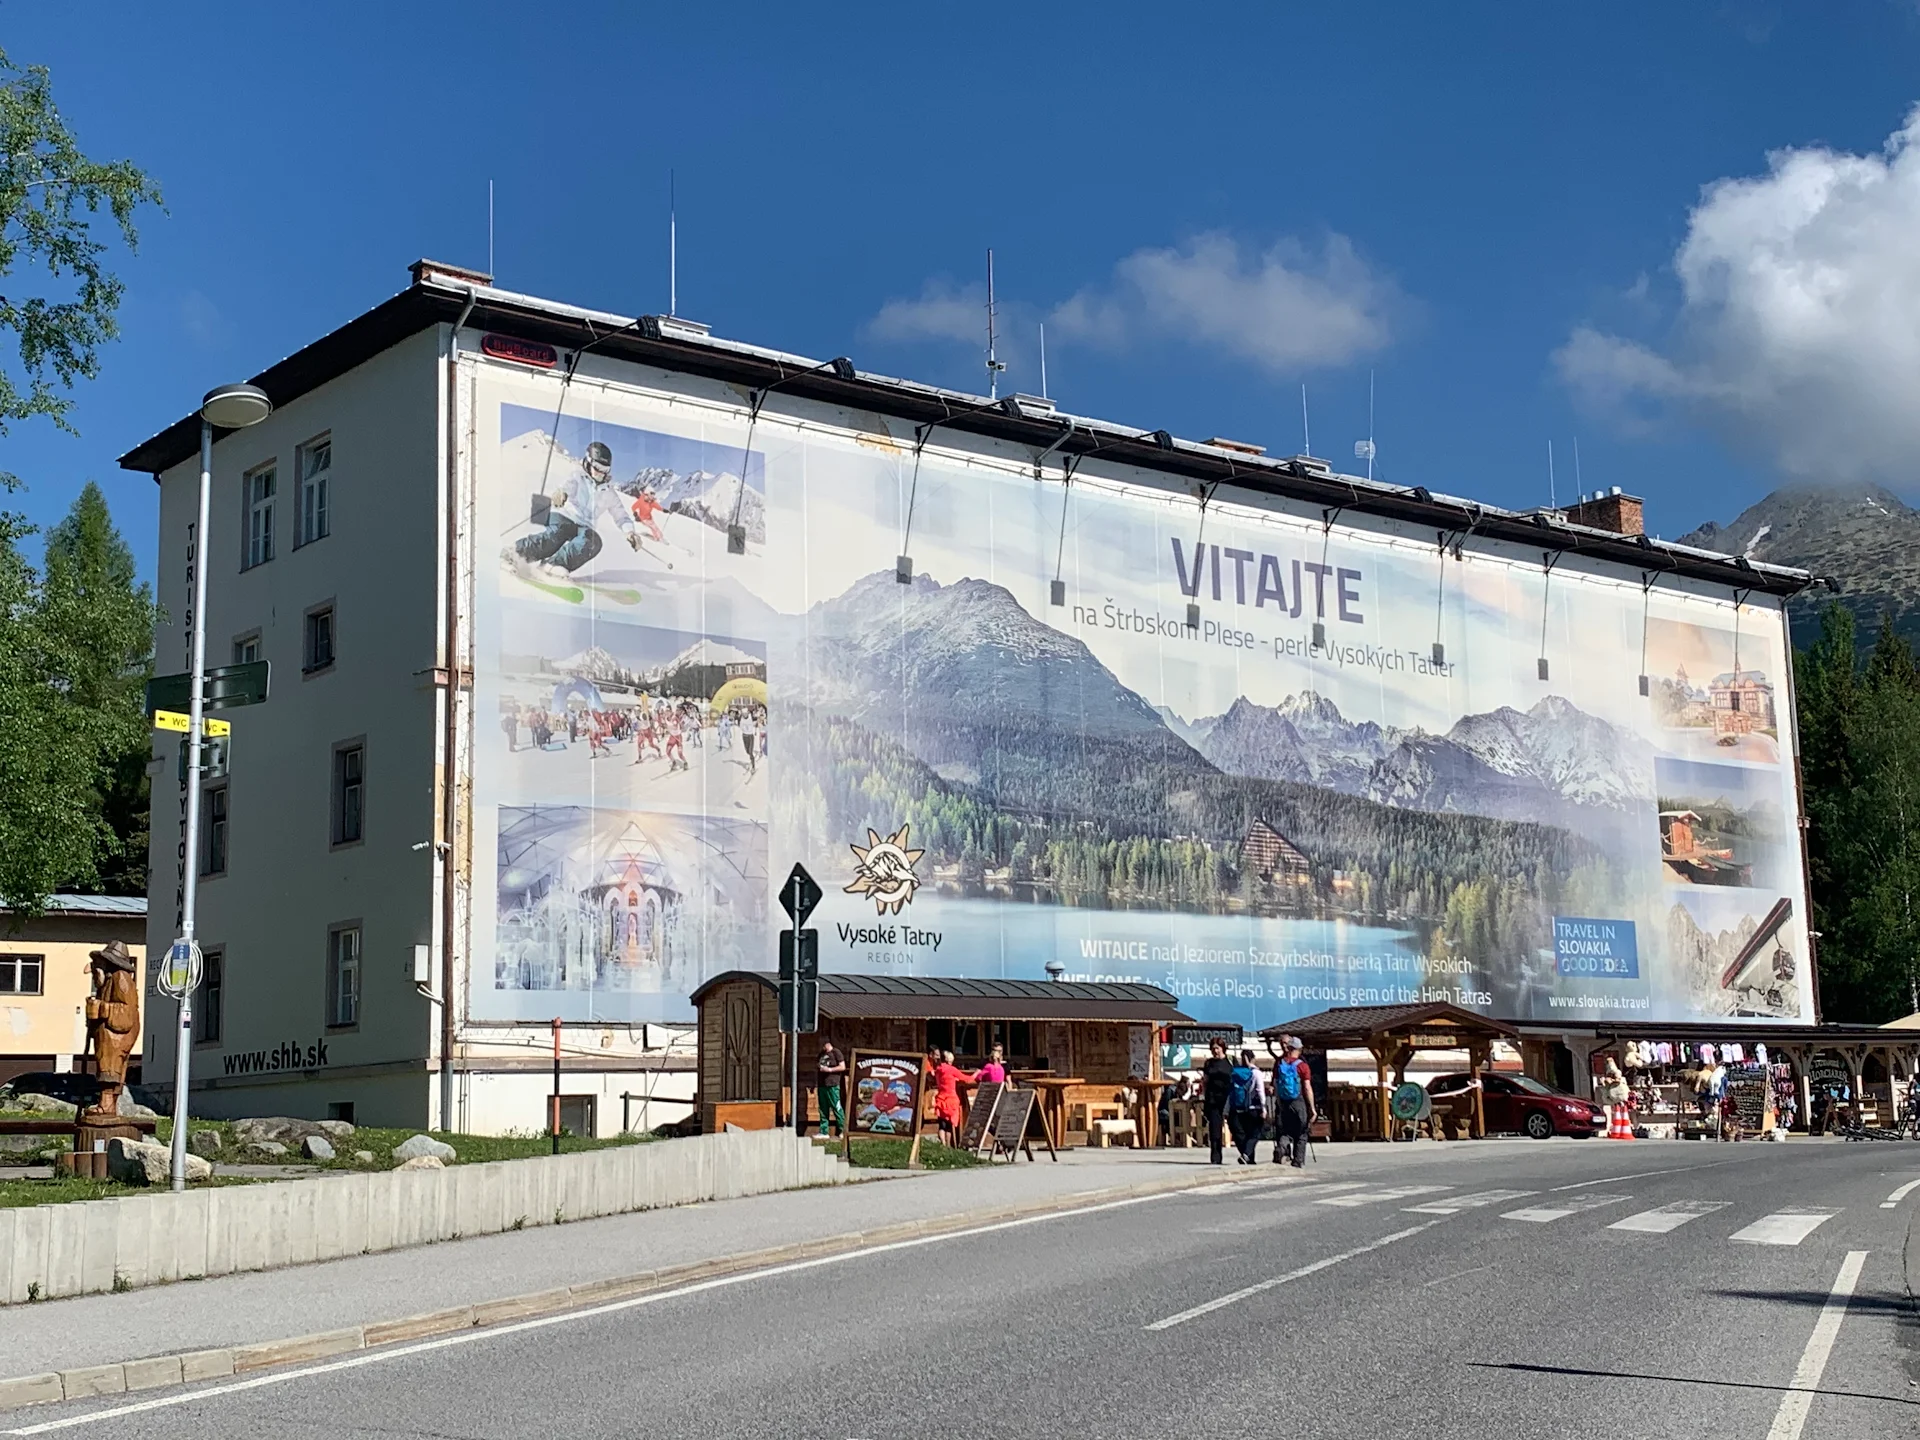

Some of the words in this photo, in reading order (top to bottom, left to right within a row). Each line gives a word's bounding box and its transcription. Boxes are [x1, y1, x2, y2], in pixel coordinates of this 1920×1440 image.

[1170, 537, 1364, 624] VITAJTE
[1073, 605, 1098, 626] na
[1104, 597, 1198, 641] Štrbskom
[1204, 620, 1255, 649] Plese
[1274, 635, 1319, 659] perle
[1323, 638, 1404, 674] Vysokých
[172, 717, 187, 728] WC
[205, 721, 218, 732] WC
[837, 922, 897, 948] Vysoké
[900, 925, 942, 952] Tatry
[1557, 923, 1599, 939] TRAVEL
[1602, 926, 1615, 939] IN
[1559, 940, 1612, 956] SLOVAKIA
[867, 952, 914, 964] REGIÓN
[1080, 939, 1149, 960] WITAJCE
[1152, 944, 1179, 962] nad
[1183, 944, 1245, 964] Jeziorem
[1249, 946, 1335, 971] Szczyrbskim
[1384, 953, 1409, 971] Tatr
[1412, 954, 1473, 977] Wysokich
[1562, 957, 1598, 972] GOOD
[1165, 971, 1221, 997] Štrbské
[1224, 979, 1264, 999] Pleso
[1278, 988, 1286, 999] a
[1290, 983, 1347, 1004] precious
[1350, 986, 1379, 1006] gem
[1382, 984, 1395, 1001] of
[1398, 986, 1419, 1003] the
[1422, 986, 1452, 1004] High
[1453, 987, 1493, 1006] Tatras
[1548, 994, 1650, 1010] www.slovakia.travel
[223, 1037, 329, 1075] www.shb.sk
